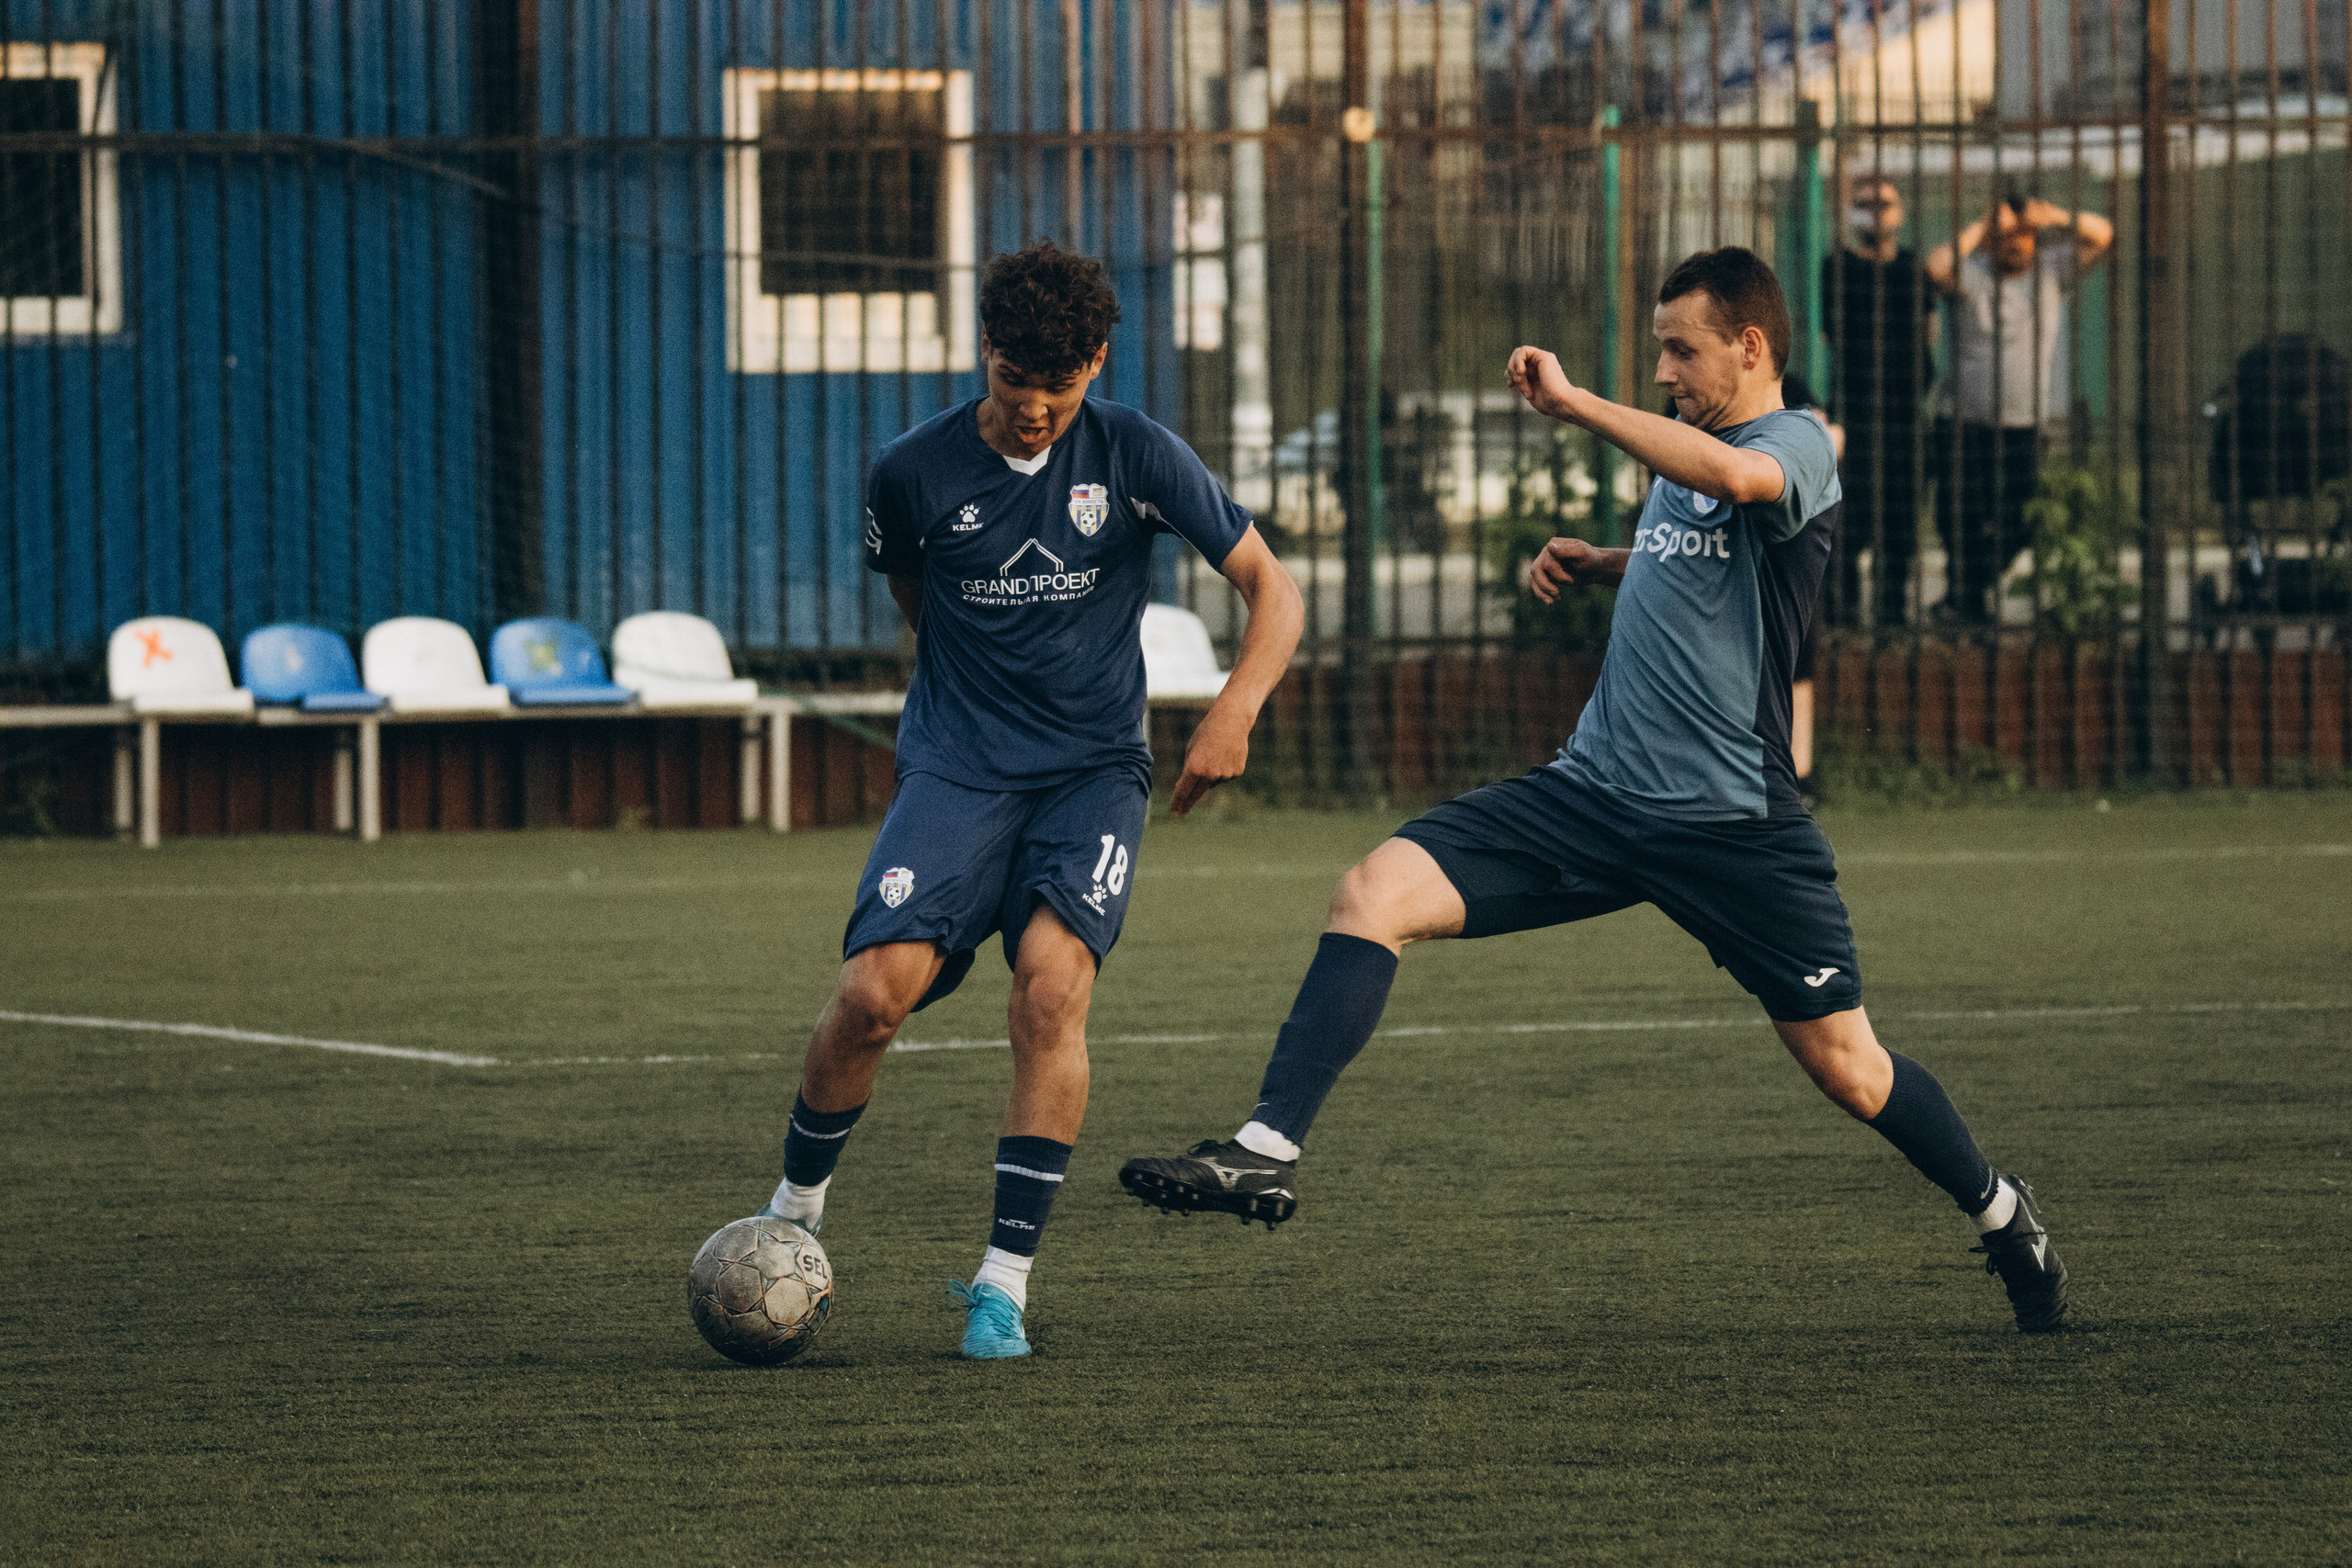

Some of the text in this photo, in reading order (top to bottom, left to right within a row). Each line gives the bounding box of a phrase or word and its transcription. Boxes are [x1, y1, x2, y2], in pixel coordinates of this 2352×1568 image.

[963, 594, 1039, 606] СТРОИТЕЛЬАЯ
[1091, 834, 1128, 896] 18
[1082, 893, 1106, 916] KELME
